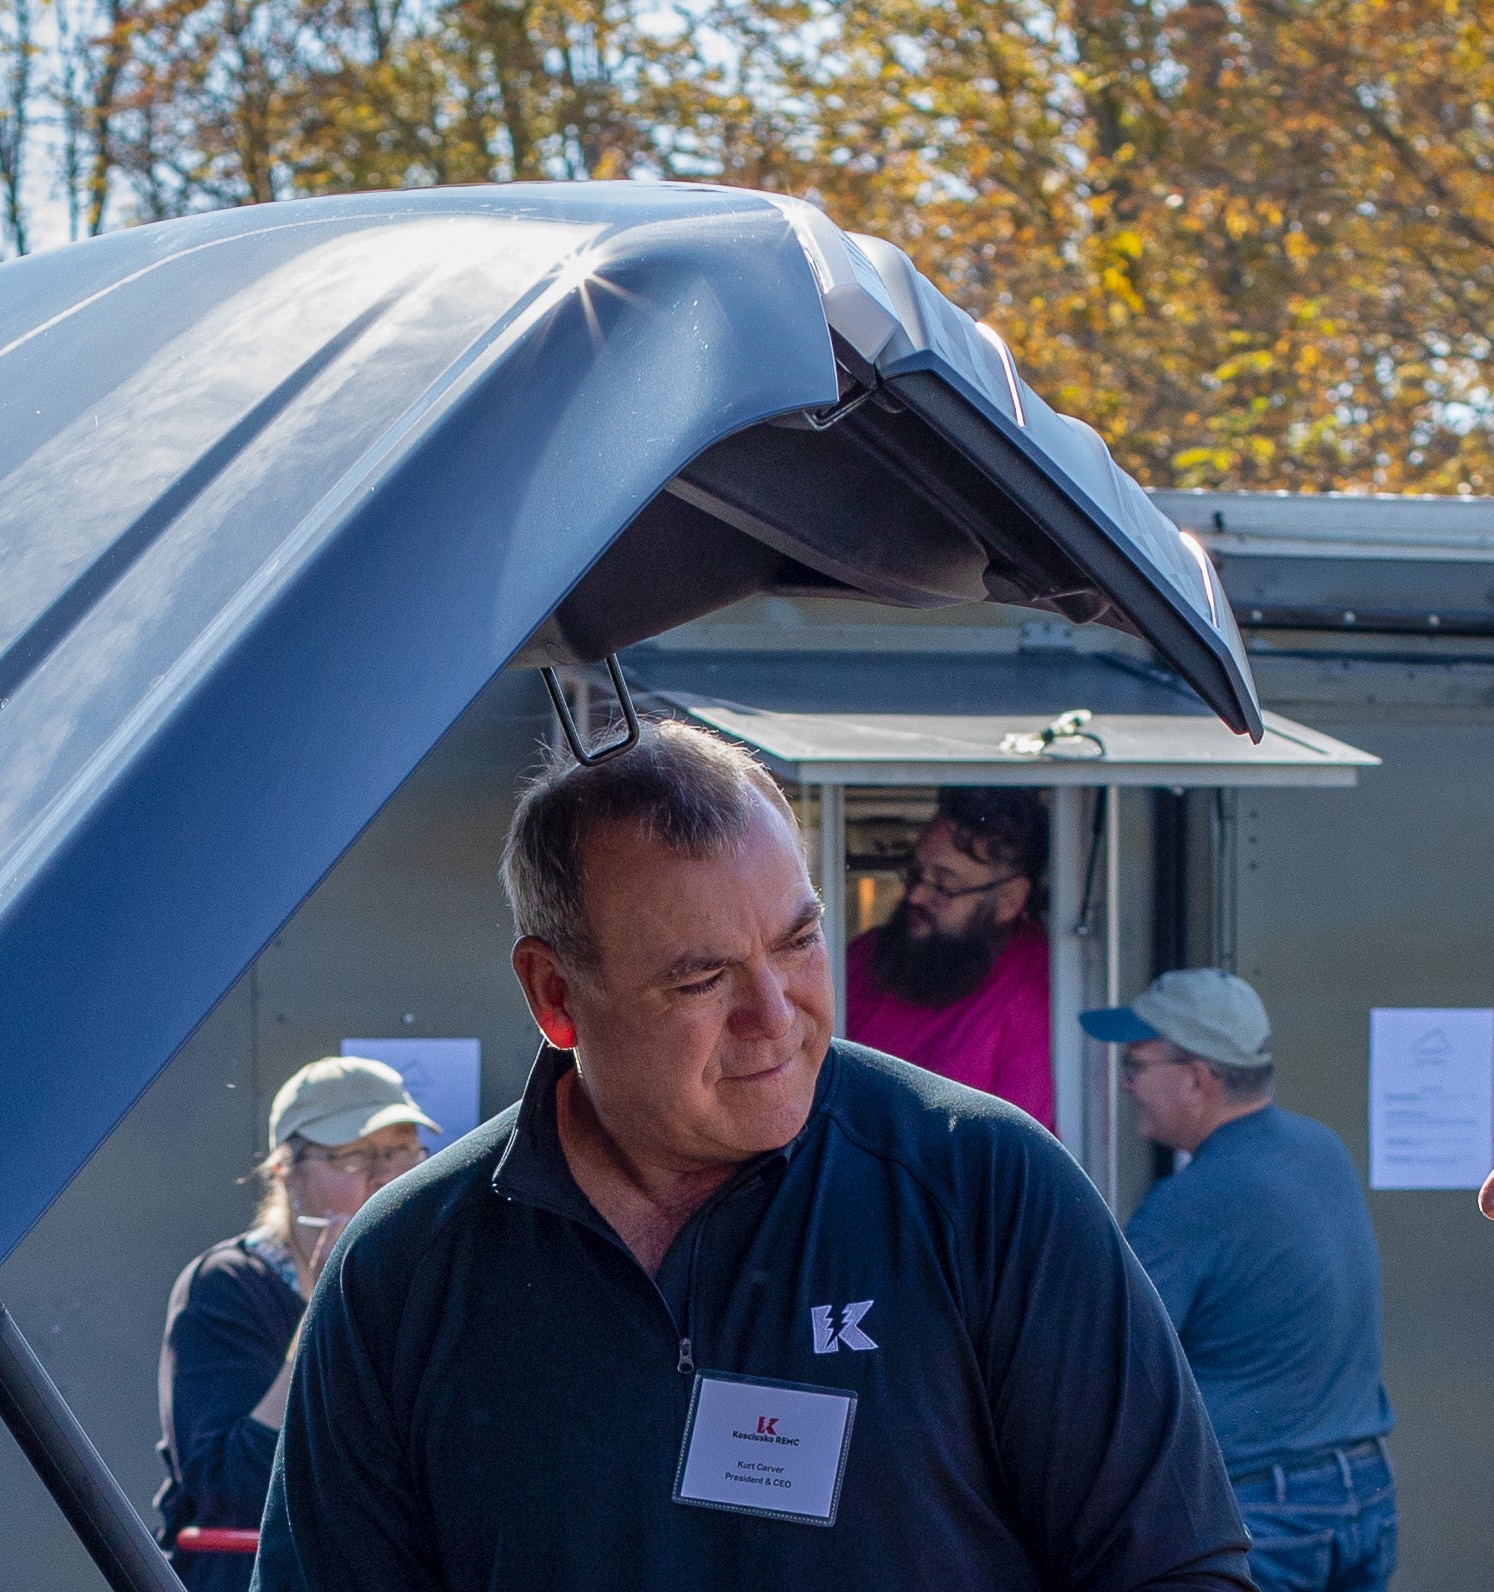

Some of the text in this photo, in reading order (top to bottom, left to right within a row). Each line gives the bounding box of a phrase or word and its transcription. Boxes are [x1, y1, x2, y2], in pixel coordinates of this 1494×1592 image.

[732, 1430, 801, 1447] Kosciusko REMC
[737, 1460, 785, 1474] Kurt Carver
[724, 1472, 792, 1489] President & CEO
